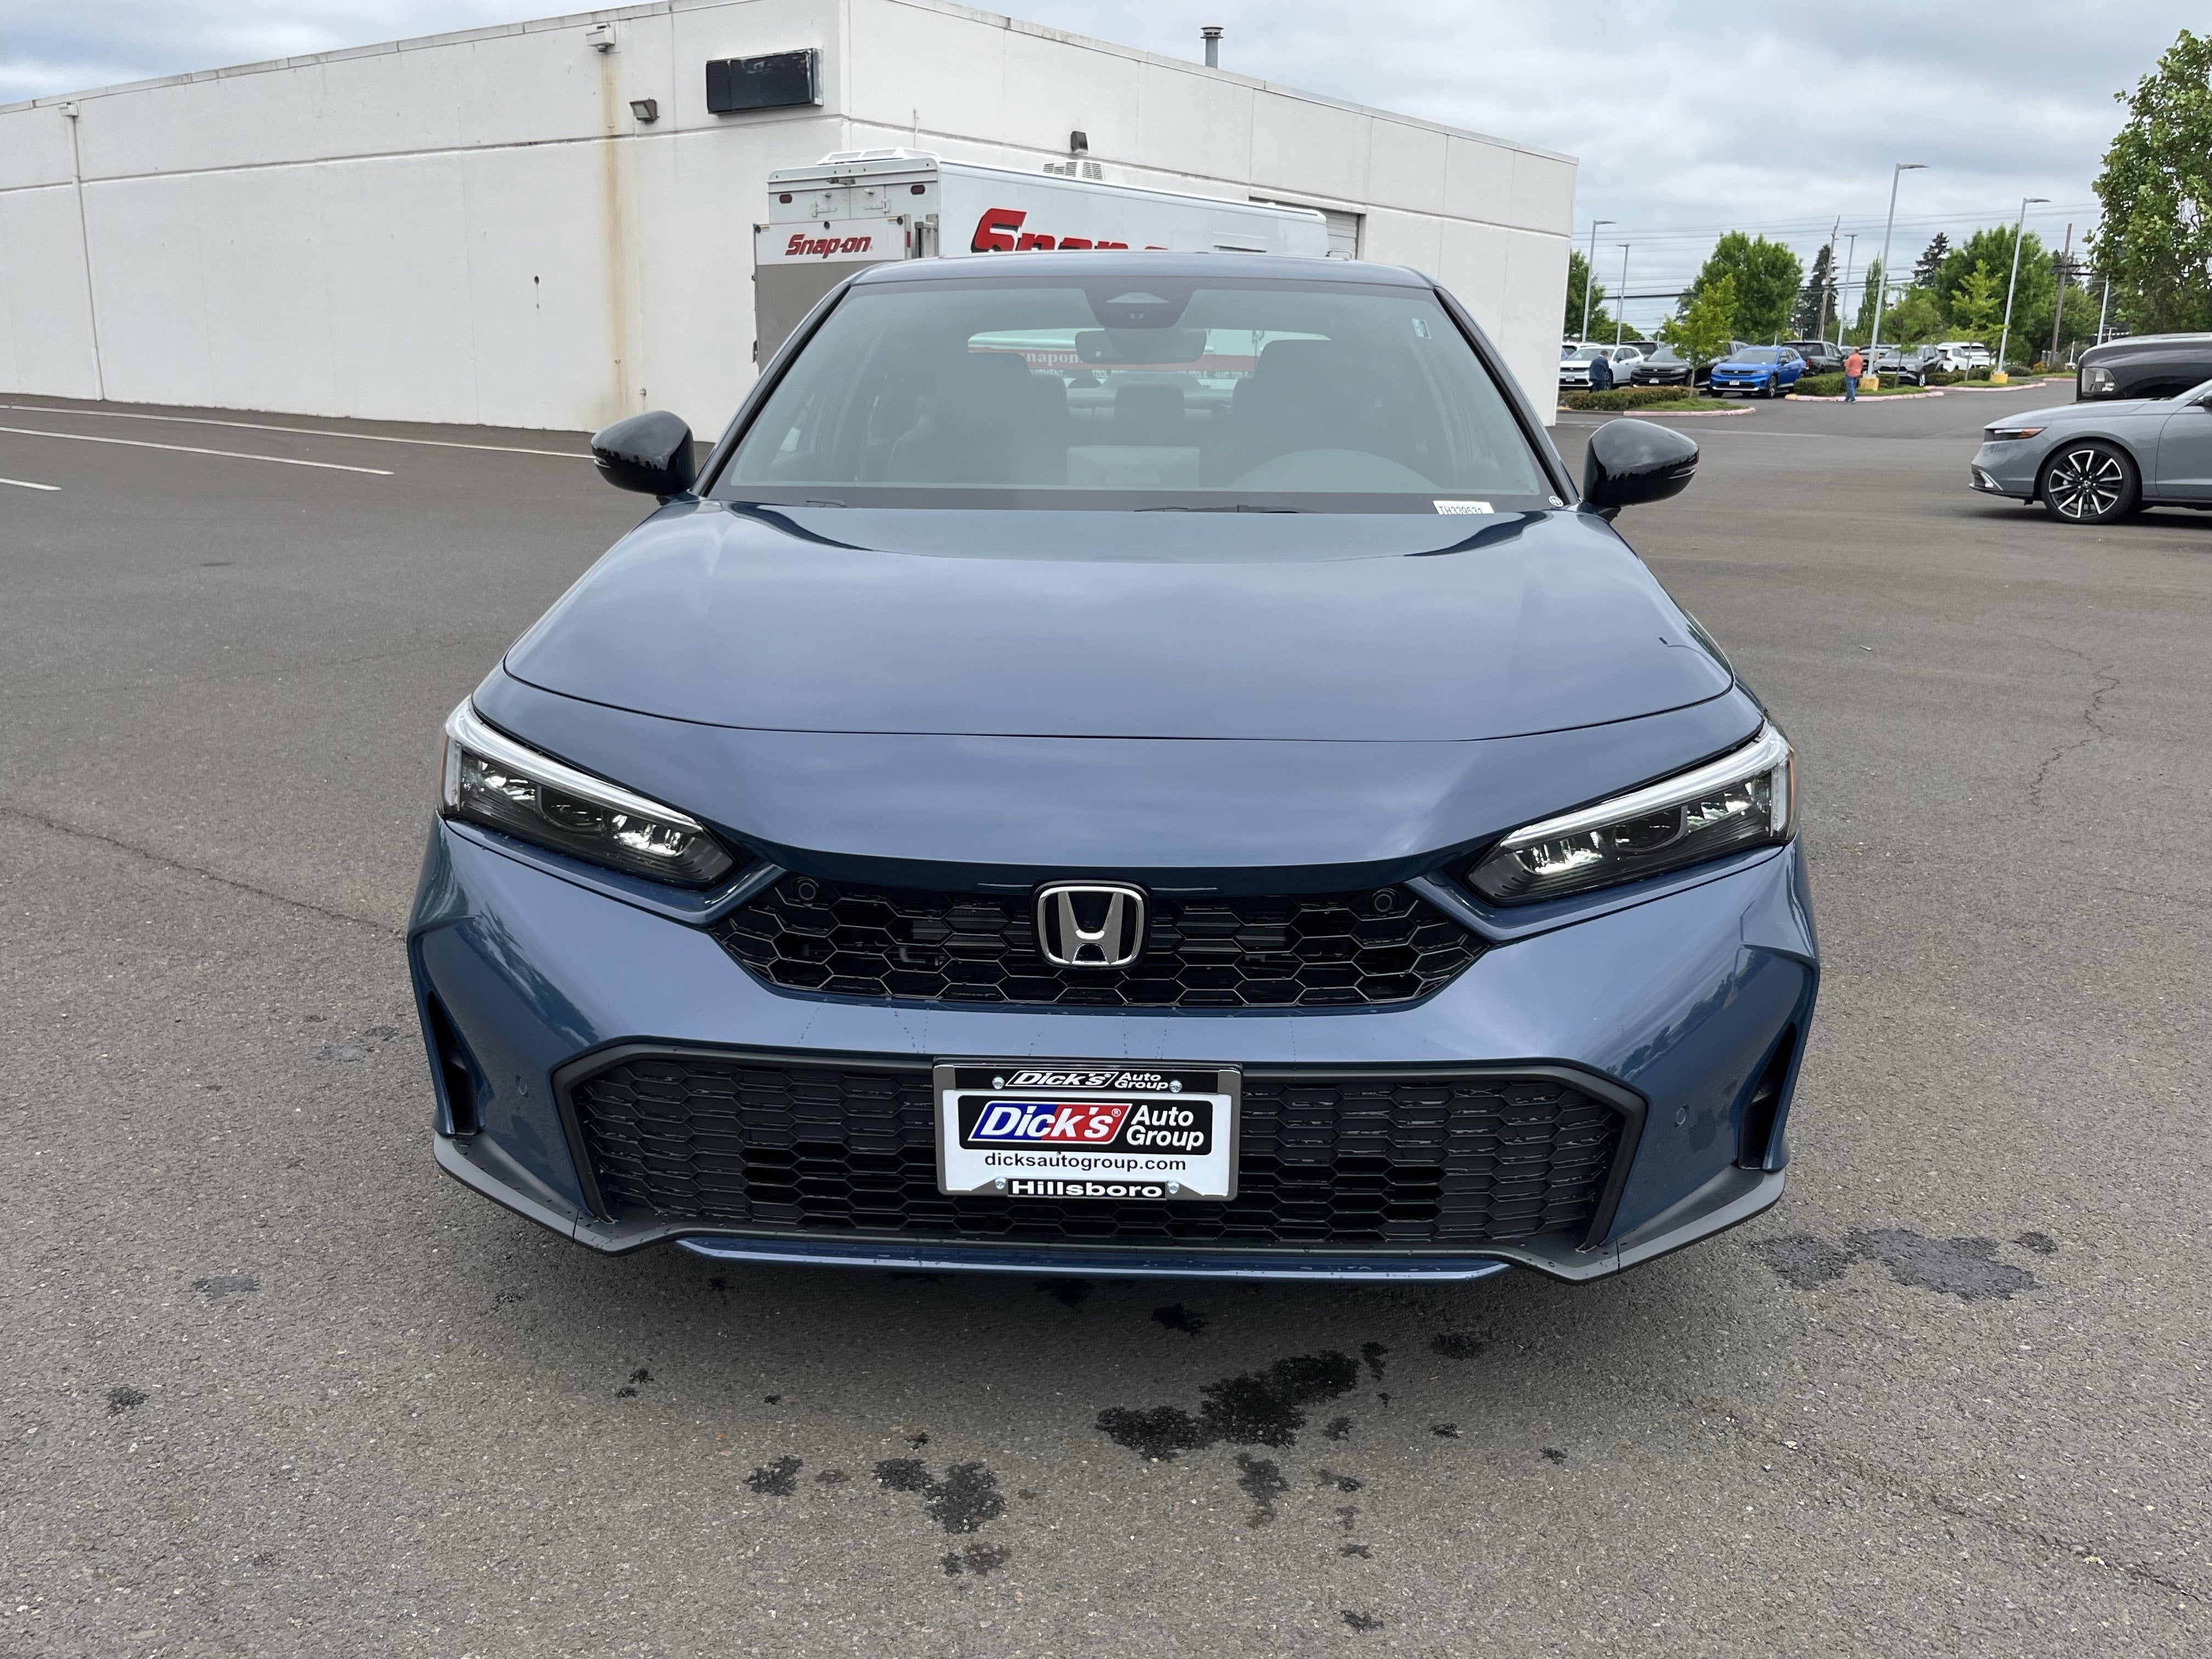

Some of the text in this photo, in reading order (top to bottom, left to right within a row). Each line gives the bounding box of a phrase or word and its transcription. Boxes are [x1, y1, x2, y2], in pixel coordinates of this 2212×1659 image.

[785, 234, 872, 259] Snap-on
[1114, 1079, 1169, 1091] Group
[1118, 1072, 1161, 1082] Auto
[1130, 1104, 1194, 1127] Auto
[1126, 1125, 1205, 1152] Group
[984, 1152, 1187, 1172] dicksautogroup.com
[1012, 1181, 1164, 1198] Hillsboro
